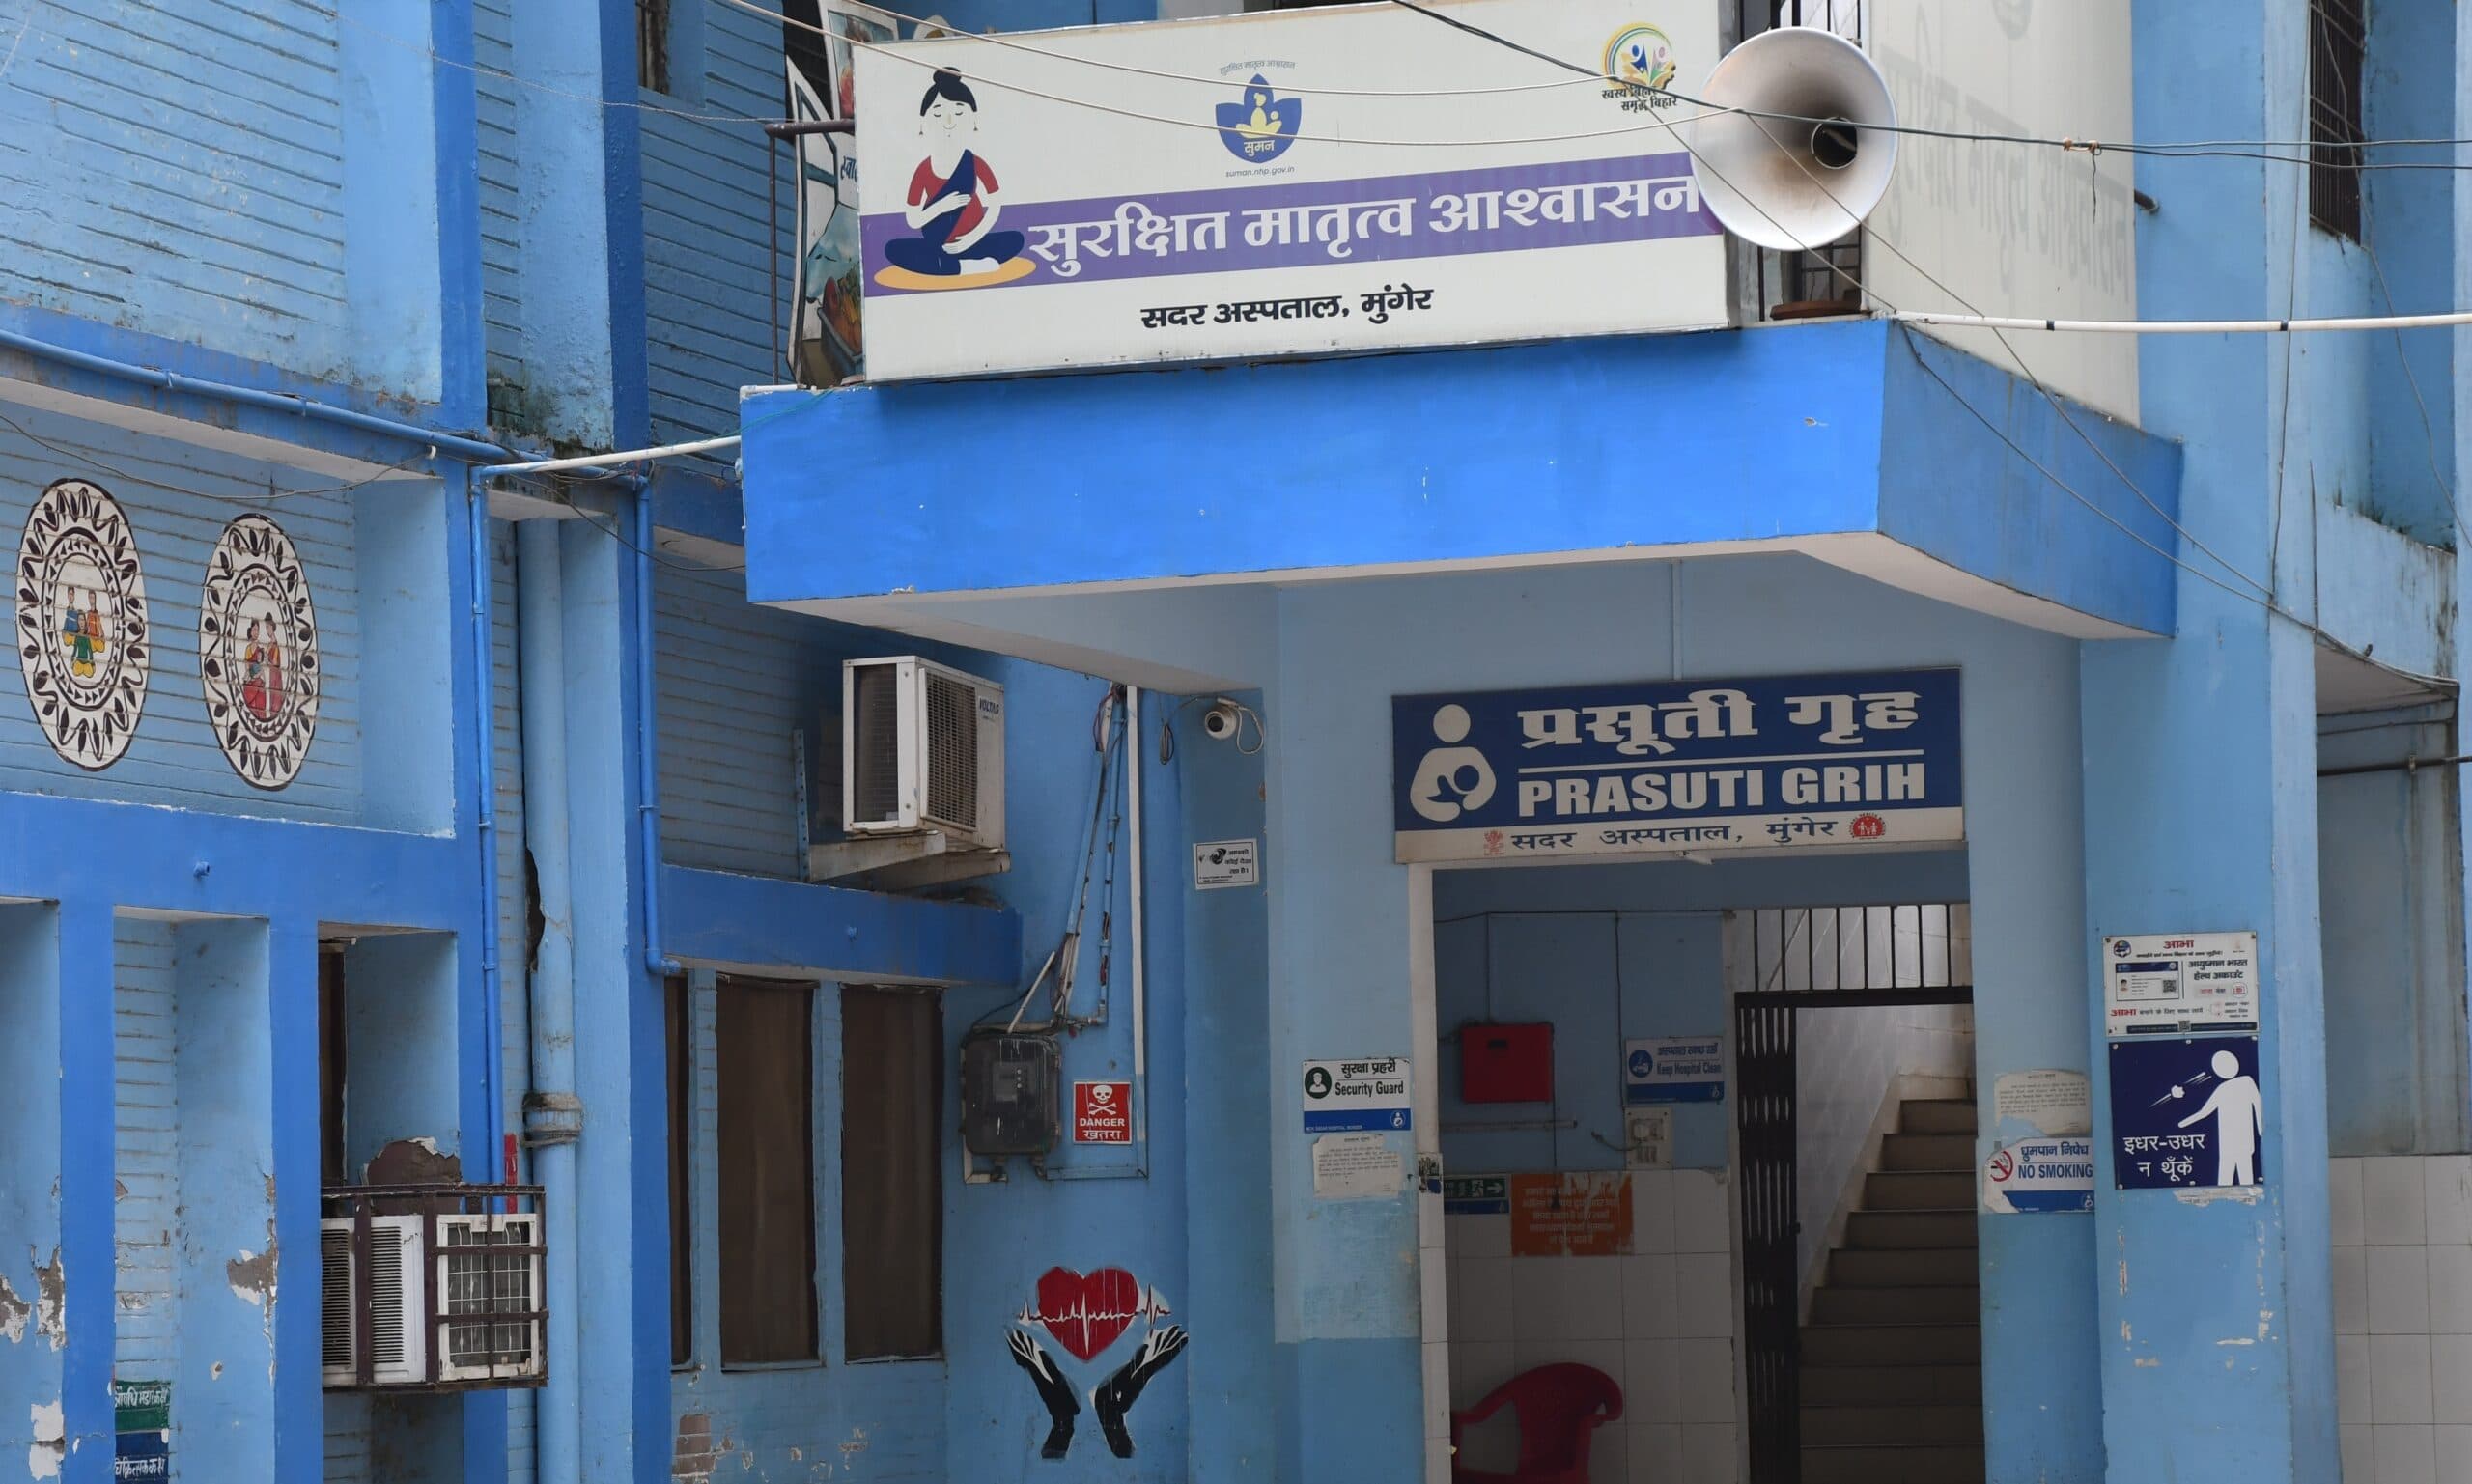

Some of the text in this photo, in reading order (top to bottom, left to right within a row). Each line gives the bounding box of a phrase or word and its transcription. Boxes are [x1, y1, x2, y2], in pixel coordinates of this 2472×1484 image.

[1244, 139, 1276, 157] सुमन
[1027, 175, 1700, 278] सुरक्षित मातृत्व आश्वासन
[1140, 282, 1435, 329] सदर अस्पताल, मुंगेर
[1517, 688, 1923, 756] प्रसूती गृह
[1518, 762, 1925, 818] PRASUTI GRIH
[1510, 831, 1579, 851] सदर
[1599, 823, 1744, 847] अस्पताल,
[1766, 815, 1840, 844] मुंगेर
[2163, 939, 2195, 949] आभा
[1341, 1058, 1396, 1078] सुरक्षा प्रहरी
[1335, 1080, 1404, 1097] Security Guard
[1079, 1117, 1125, 1127] DANGER
[1082, 1130, 1122, 1140] खतरा
[2122, 1134, 2206, 1155] इधर-उधर
[2061, 1141, 2089, 1156] निषेध
[2018, 1163, 2093, 1179] NO SMOKING
[2137, 1155, 2193, 1182] न थूँकें
